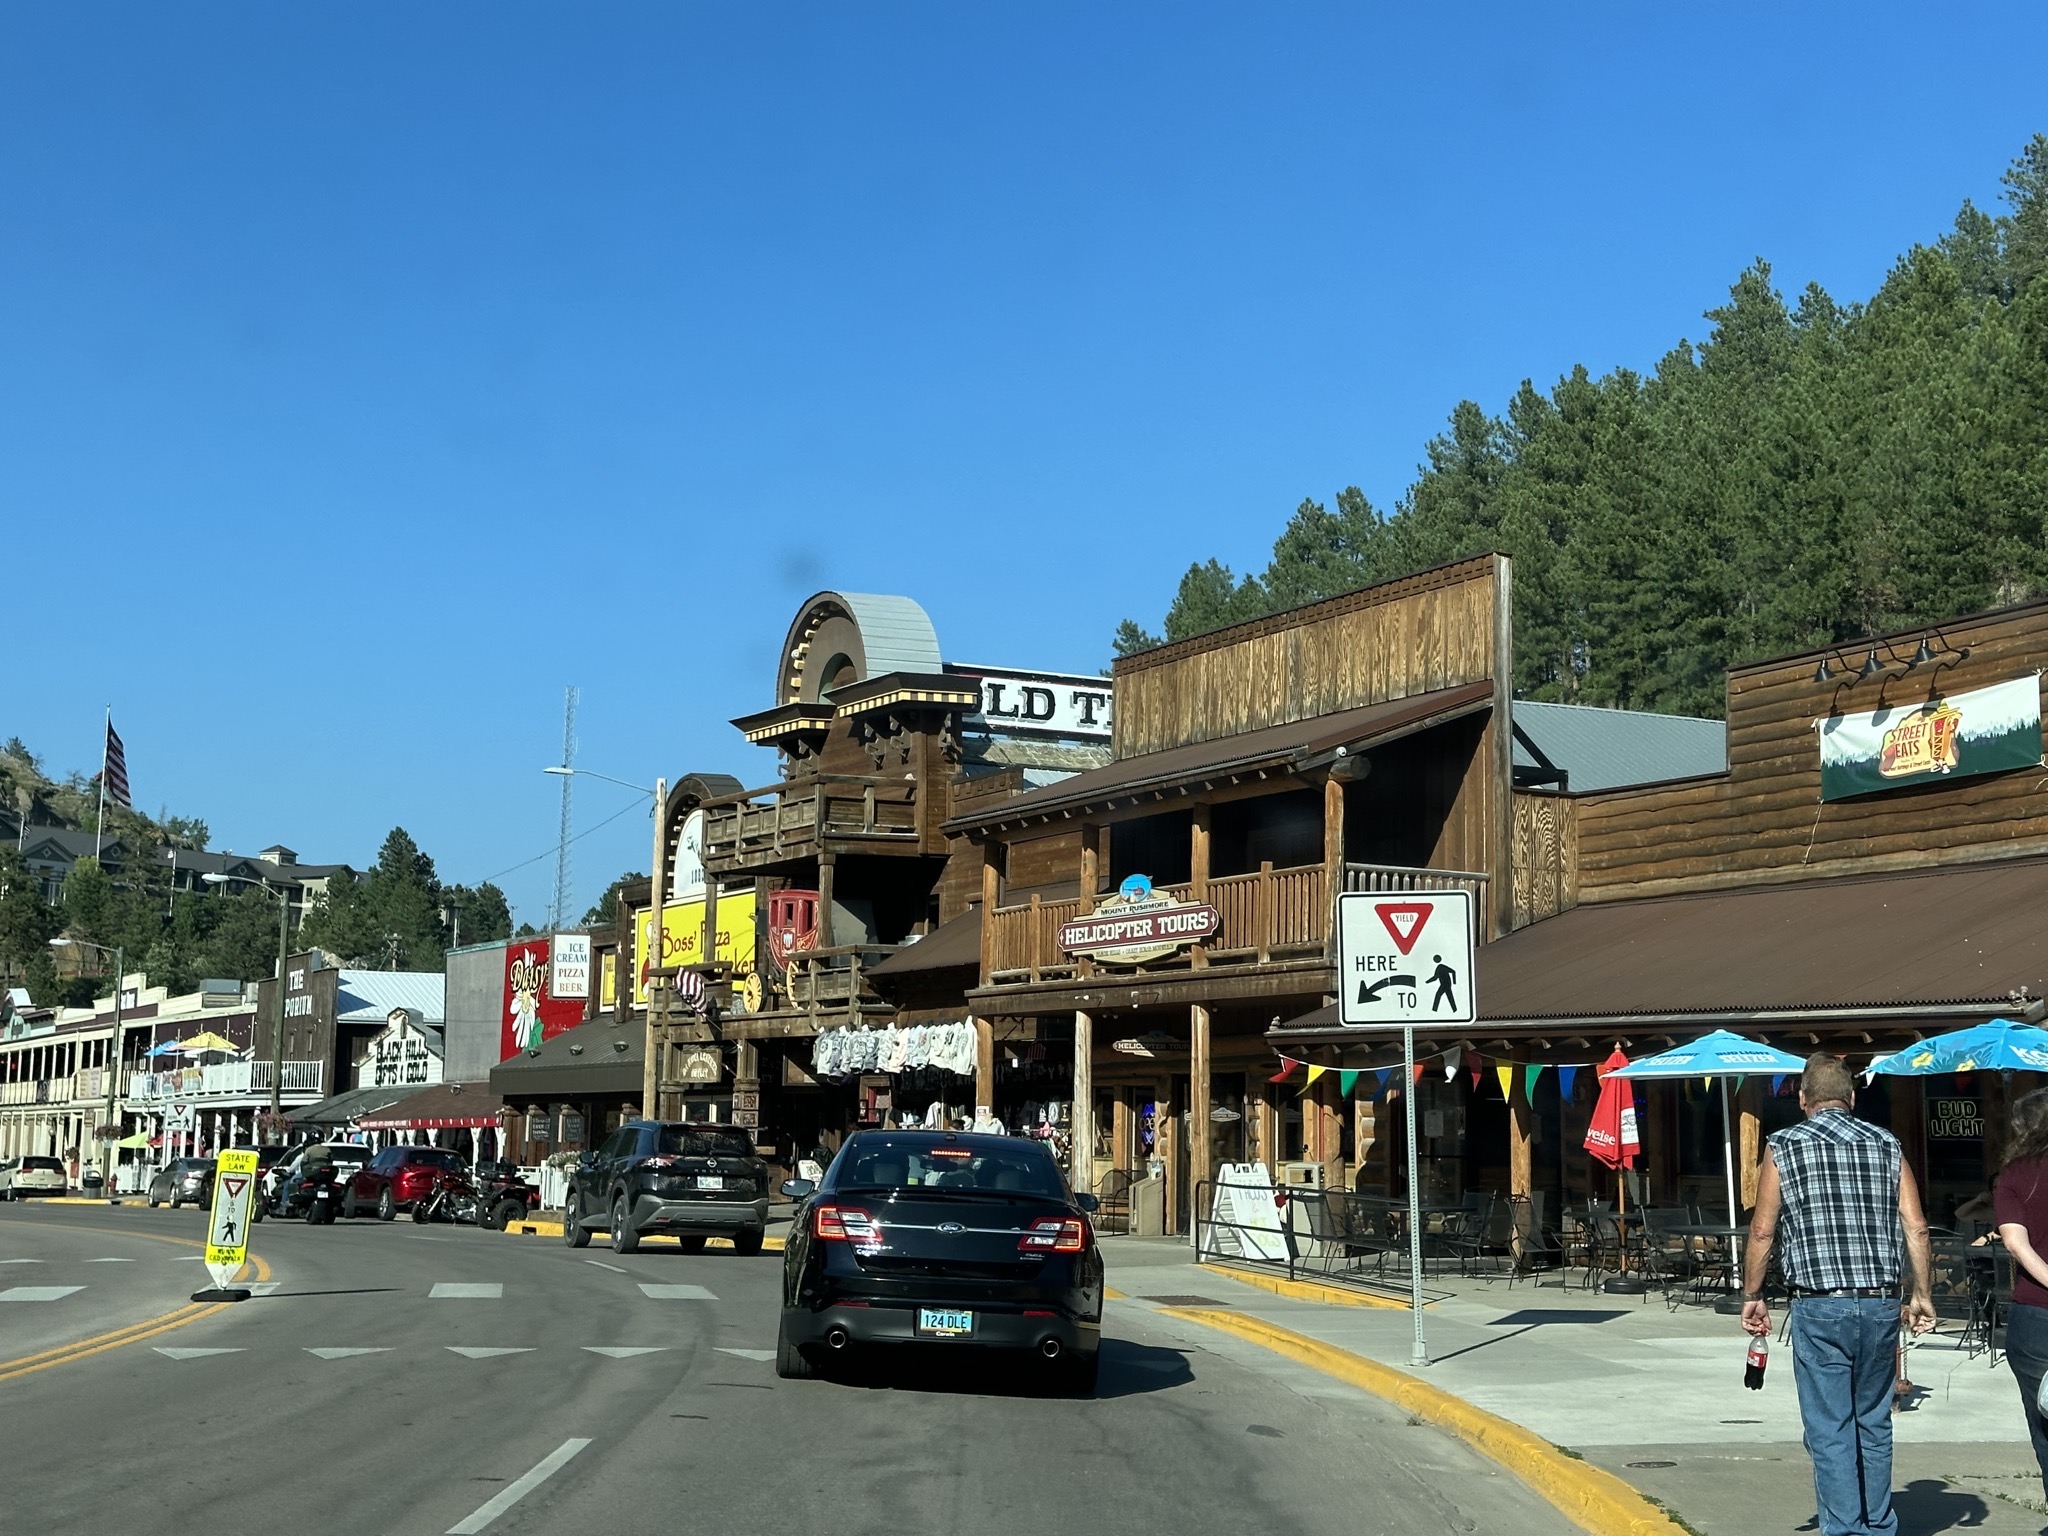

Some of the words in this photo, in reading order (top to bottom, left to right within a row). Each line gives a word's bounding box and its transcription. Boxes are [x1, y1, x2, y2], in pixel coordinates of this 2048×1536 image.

[976, 683, 1055, 721] LD
[1890, 723, 1928, 742] STREET
[1895, 740, 1920, 758] EATS
[1101, 906, 1128, 916] MOUNT
[1129, 901, 1169, 913] RUSHMORE
[1395, 914, 1414, 923] YIELD
[1065, 918, 1153, 945] HELICOPTER
[1158, 911, 1208, 935] TOURS
[569, 943, 584, 952] ICE
[661, 927, 697, 959] Boss'
[700, 920, 731, 954] Pzza
[556, 953, 588, 963] CREAM
[1355, 955, 1398, 972] HERE
[289, 969, 304, 991] THE
[558, 968, 585, 978] PIZZA
[510, 958, 548, 1008] Daisy
[559, 982, 583, 992] BEER
[285, 995, 313, 1018] PORIUM
[1398, 992, 1417, 1009] TO
[376, 1040, 403, 1063] BLACK
[406, 1038, 429, 1061] HILLS
[1117, 1042, 1167, 1050] HELICOPTER
[1718, 1055, 1780, 1063] SELTZER
[375, 1063, 398, 1086] GIFTS
[407, 1061, 428, 1083] GOLD
[1938, 1100, 1977, 1118] BUD
[1930, 1118, 1985, 1137] LIGHT
[226, 1153, 250, 1163] STATE
[926, 1315, 944, 1329] 124
[947, 1315, 967, 1329] DLE
